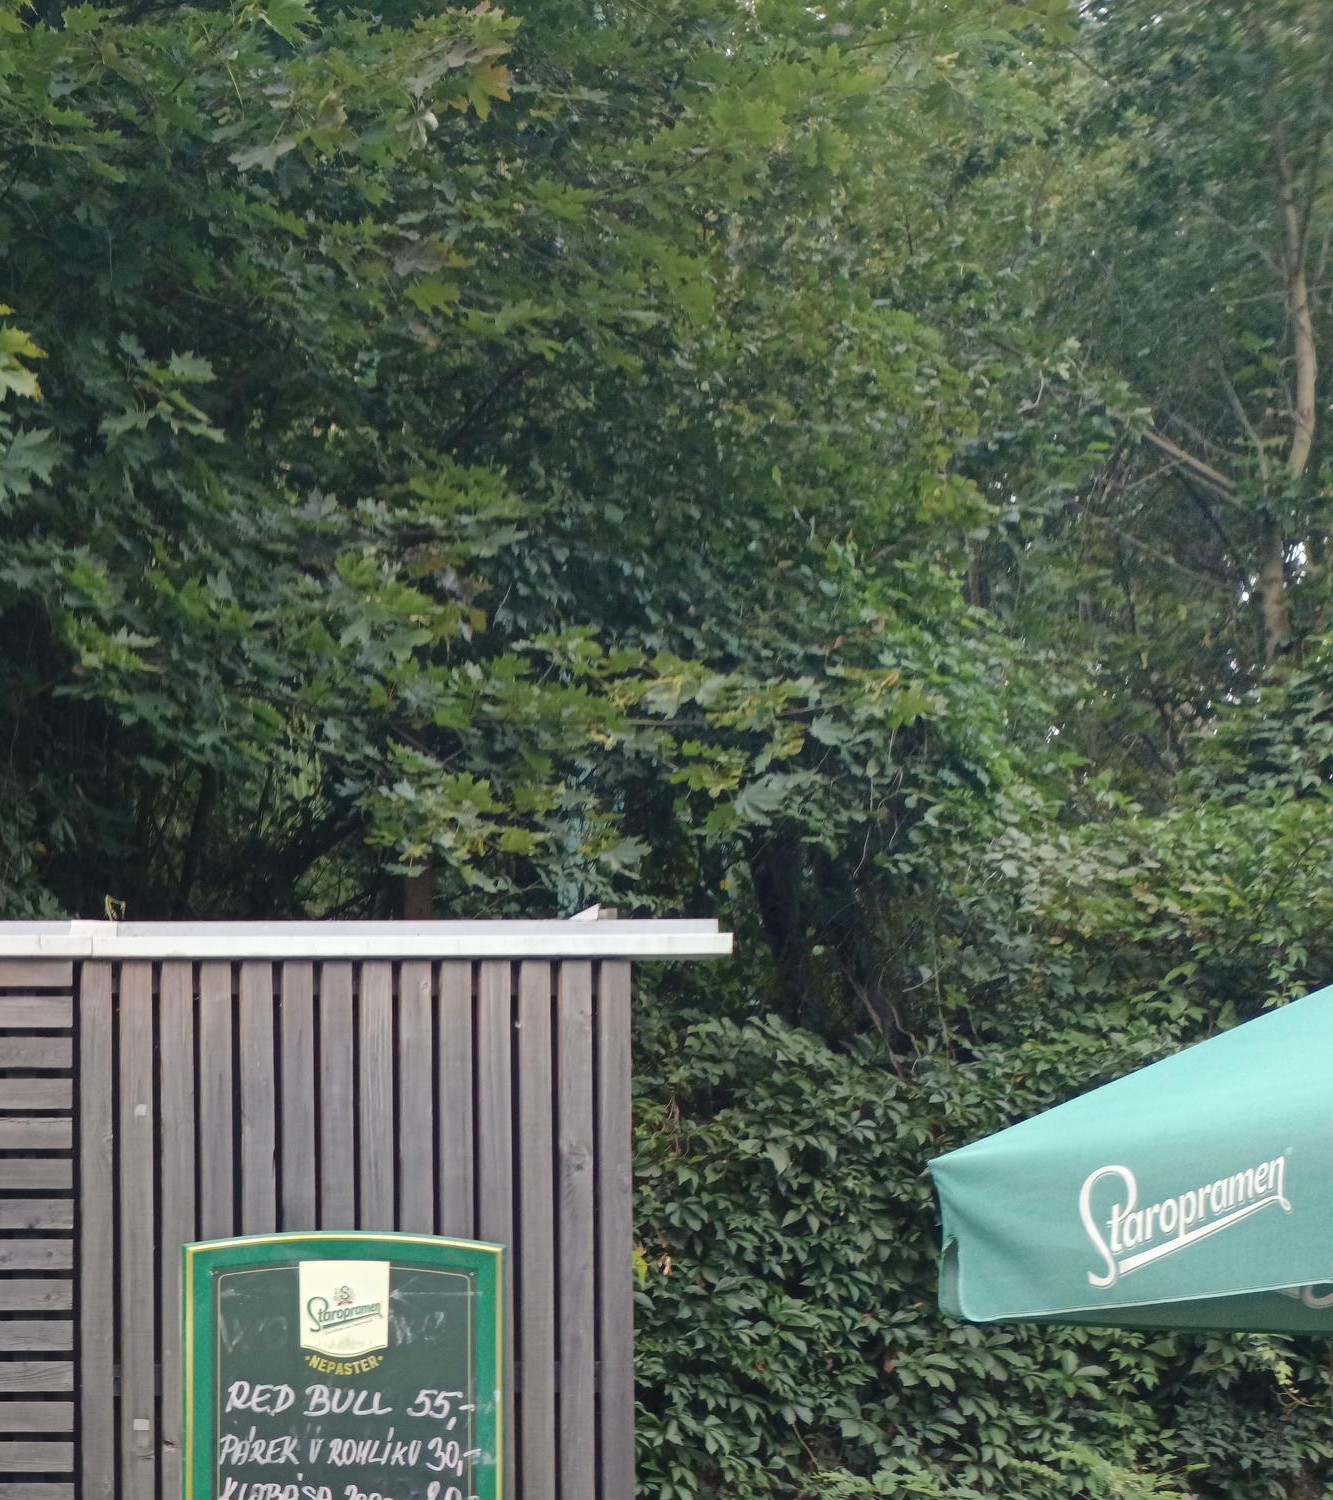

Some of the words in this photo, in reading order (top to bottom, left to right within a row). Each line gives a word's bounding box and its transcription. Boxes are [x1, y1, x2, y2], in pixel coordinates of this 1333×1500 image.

[1079, 1153, 1294, 1289] Staropramen
[307, 1296, 384, 1333] Staropramen
[308, 1354, 380, 1376] NEPASTER
[225, 1380, 296, 1416] RED
[303, 1384, 393, 1416] BULL
[219, 1425, 300, 1467] PÁREK
[308, 1438, 323, 1465] V
[327, 1426, 423, 1467] ROHLÍKU
